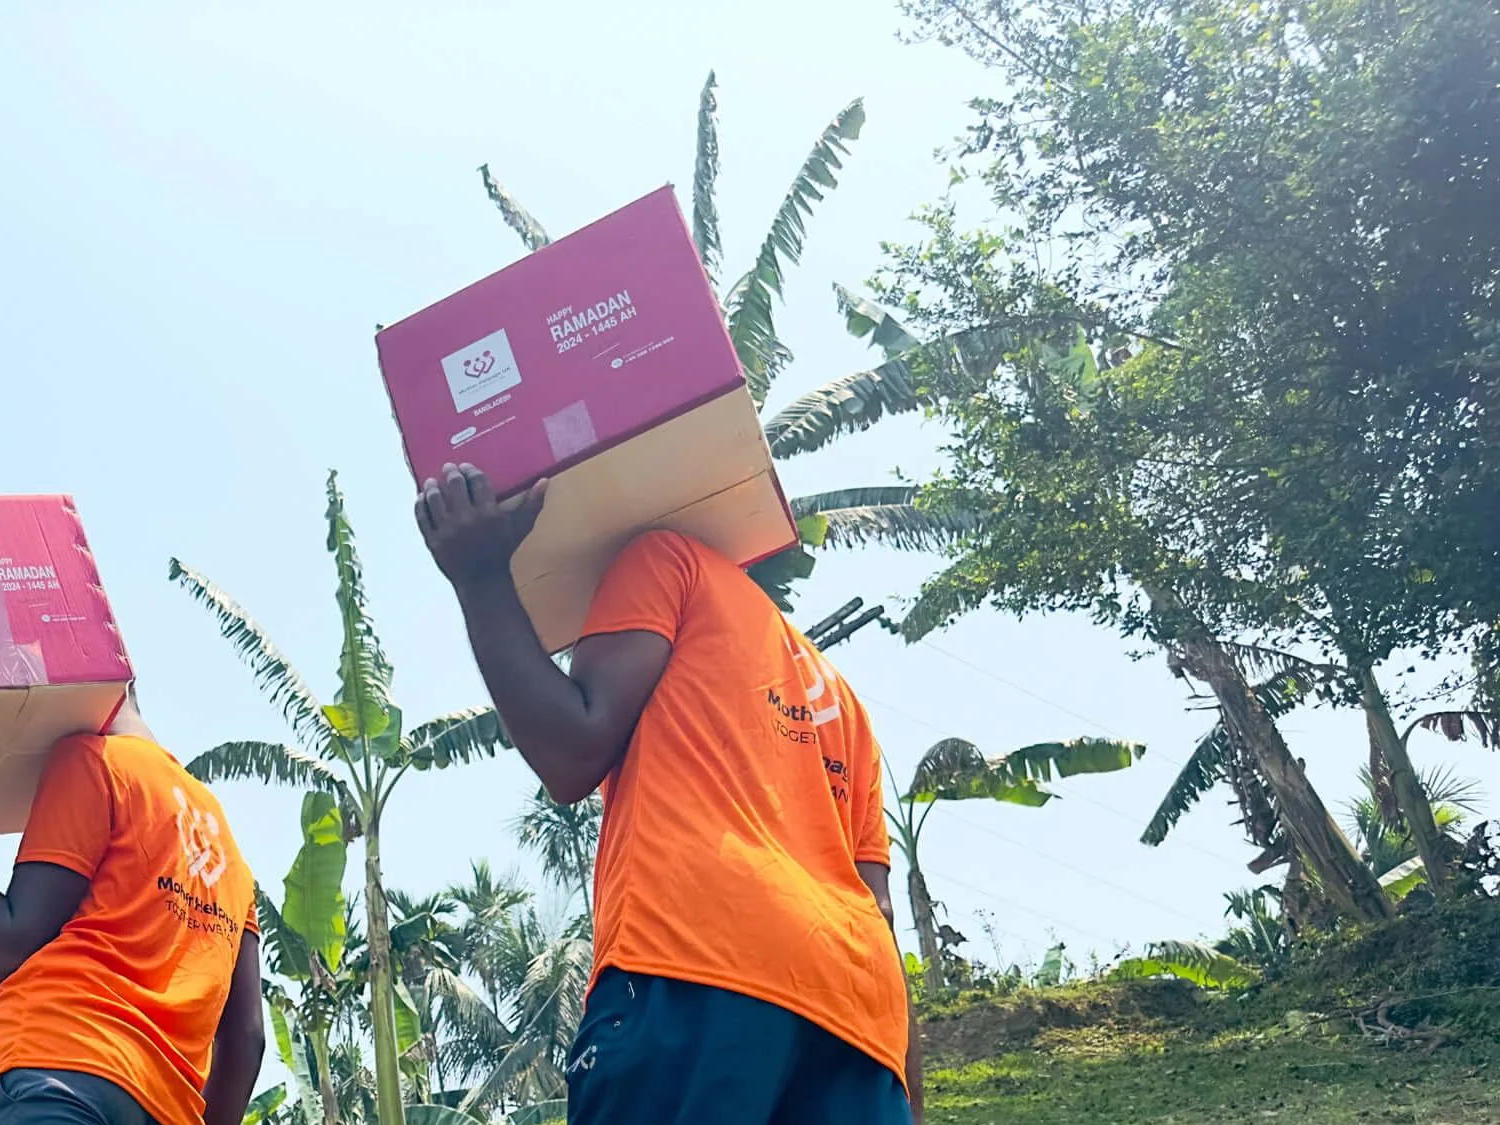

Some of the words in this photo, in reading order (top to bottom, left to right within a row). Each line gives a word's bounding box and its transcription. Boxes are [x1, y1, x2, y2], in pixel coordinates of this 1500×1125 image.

[546, 305, 573, 326] HAPPY
[550, 290, 632, 342] RAMADAN
[556, 333, 583, 355] 2024
[591, 317, 618, 336] 1445
[620, 306, 637, 322] AH
[2, 580, 21, 592] 2024
[26, 580, 46, 590] 1445
[767, 688, 814, 722] Moth
